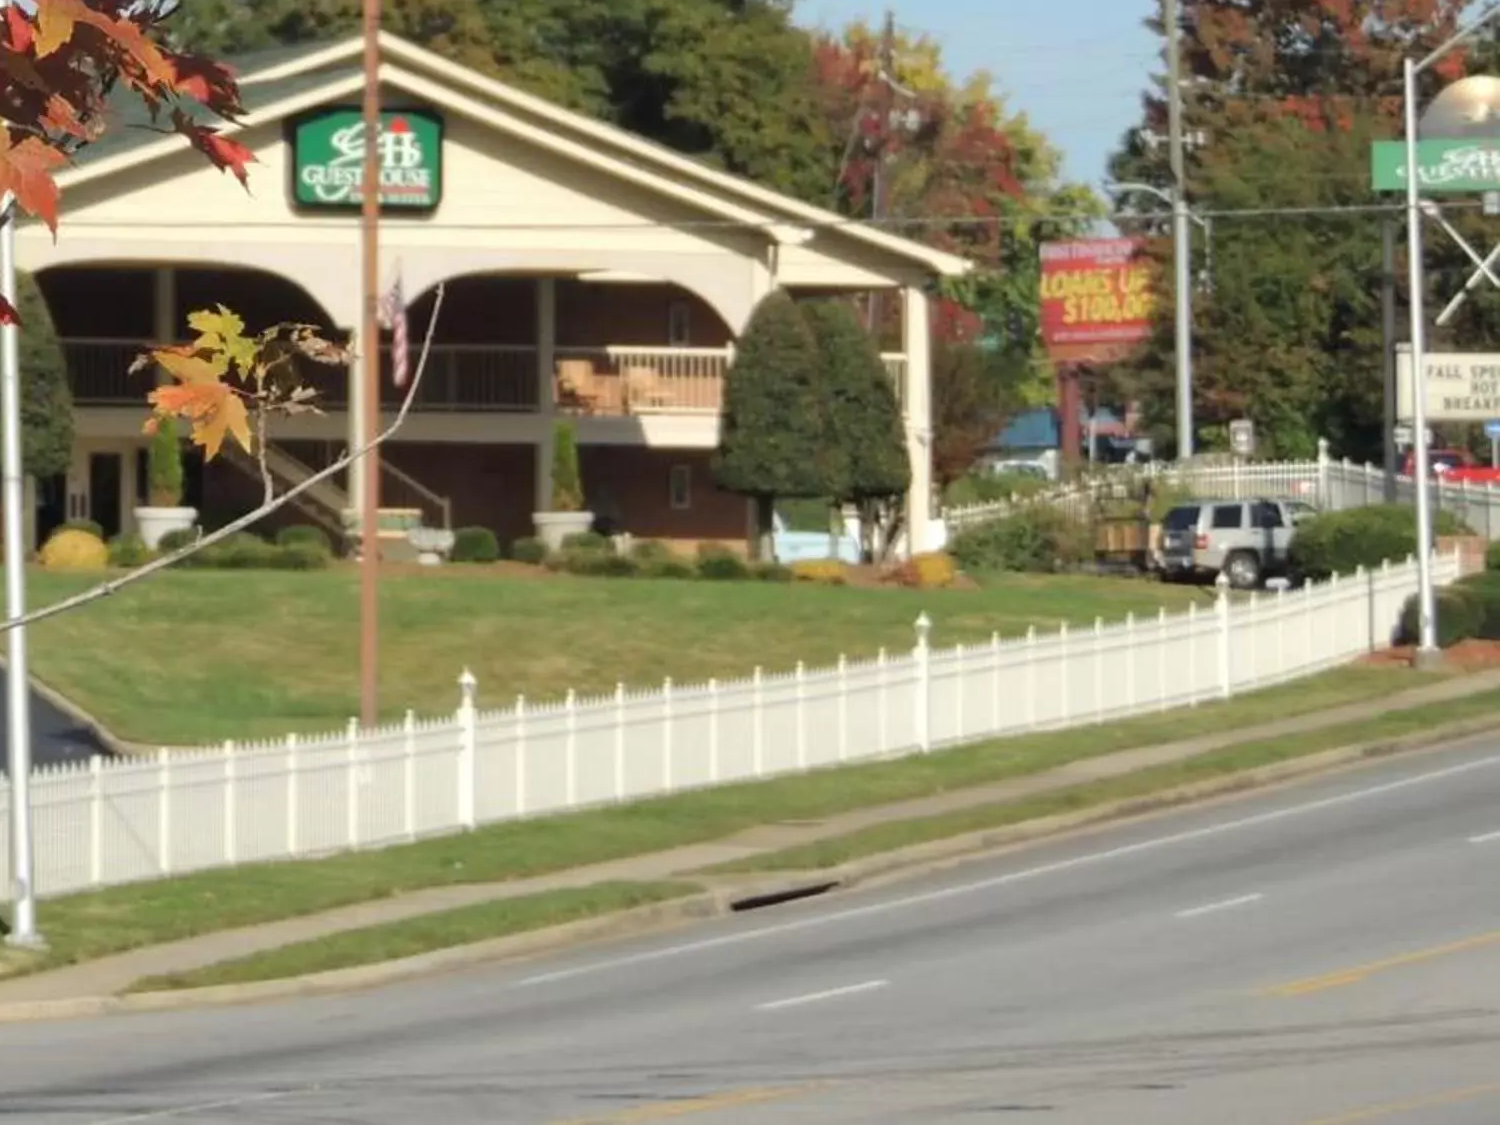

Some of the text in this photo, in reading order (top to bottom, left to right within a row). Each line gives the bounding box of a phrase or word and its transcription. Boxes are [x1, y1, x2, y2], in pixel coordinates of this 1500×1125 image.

[301, 164, 431, 187] GUESTOUSE
[1040, 268, 1112, 299] LOANS
[1427, 363, 1500, 379] FALL SPE
